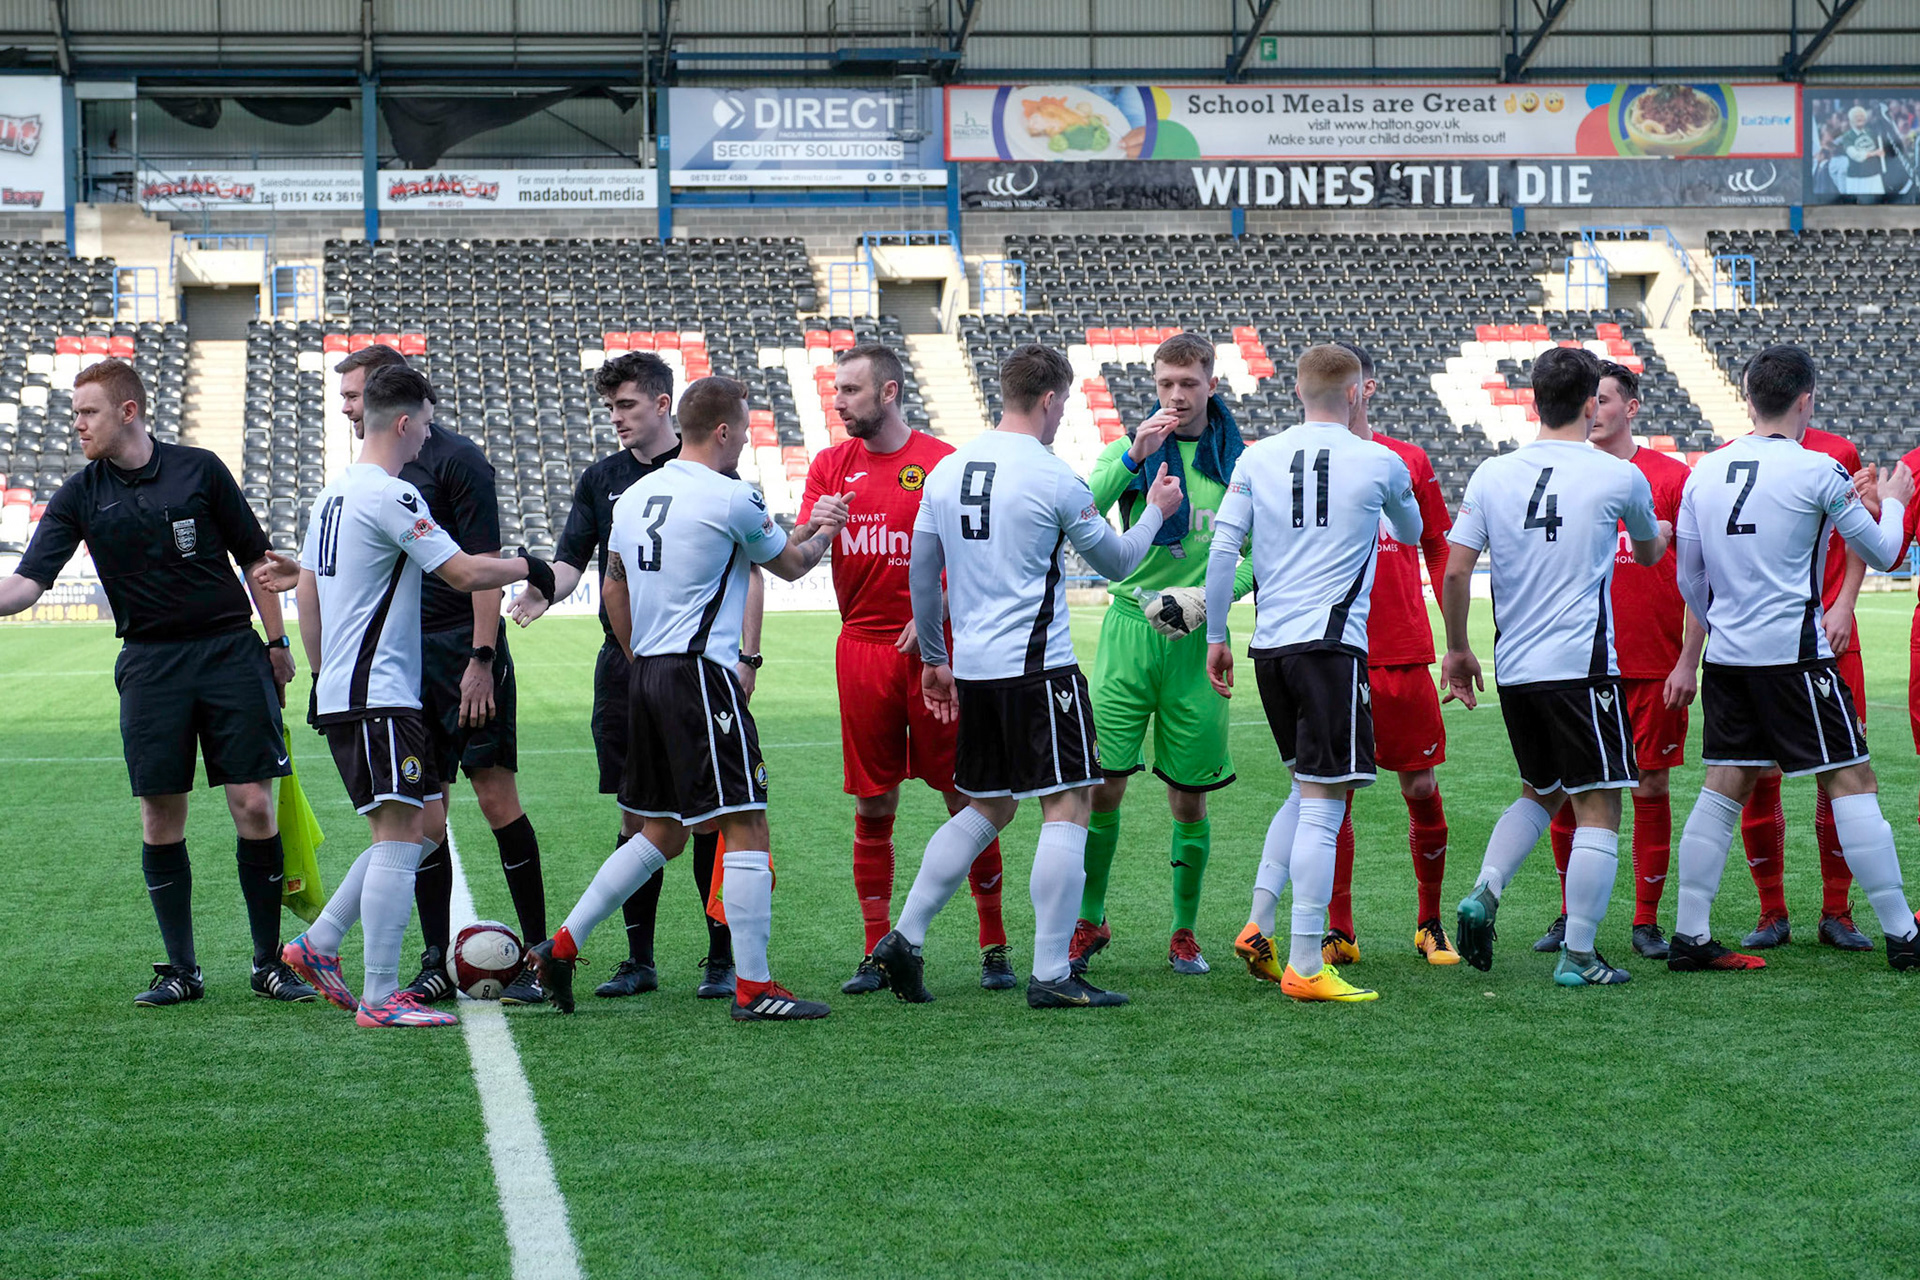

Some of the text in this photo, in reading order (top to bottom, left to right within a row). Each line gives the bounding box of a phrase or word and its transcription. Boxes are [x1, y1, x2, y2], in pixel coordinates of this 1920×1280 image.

[754, 97, 904, 130] DIRECT
[1188, 93, 1497, 114] School Meals are Great
[1308, 117, 1460, 132] visit www.halton.gov.uk
[717, 143, 901, 158] SECURITY SOLUTIONS
[1267, 131, 1506, 148] Make sure your child doesn't miss out!
[518, 175, 645, 185] For more information checkout
[1191, 166, 1375, 206] WIDNES
[1487, 165, 1499, 205] I
[1517, 165, 1593, 204] DIE
[260, 191, 363, 203] Tel: 0151 424 3619
[519, 186, 645, 202] madabout.media
[960, 461, 997, 540] 9
[1289, 449, 1330, 528] 11
[1726, 460, 1760, 536] 2
[1524, 467, 1563, 542] 4
[846, 513, 887, 524] TEWART
[318, 496, 344, 577] 10
[638, 496, 673, 572] 3
[840, 524, 911, 556] Miln
[887, 557, 912, 567] HOM
